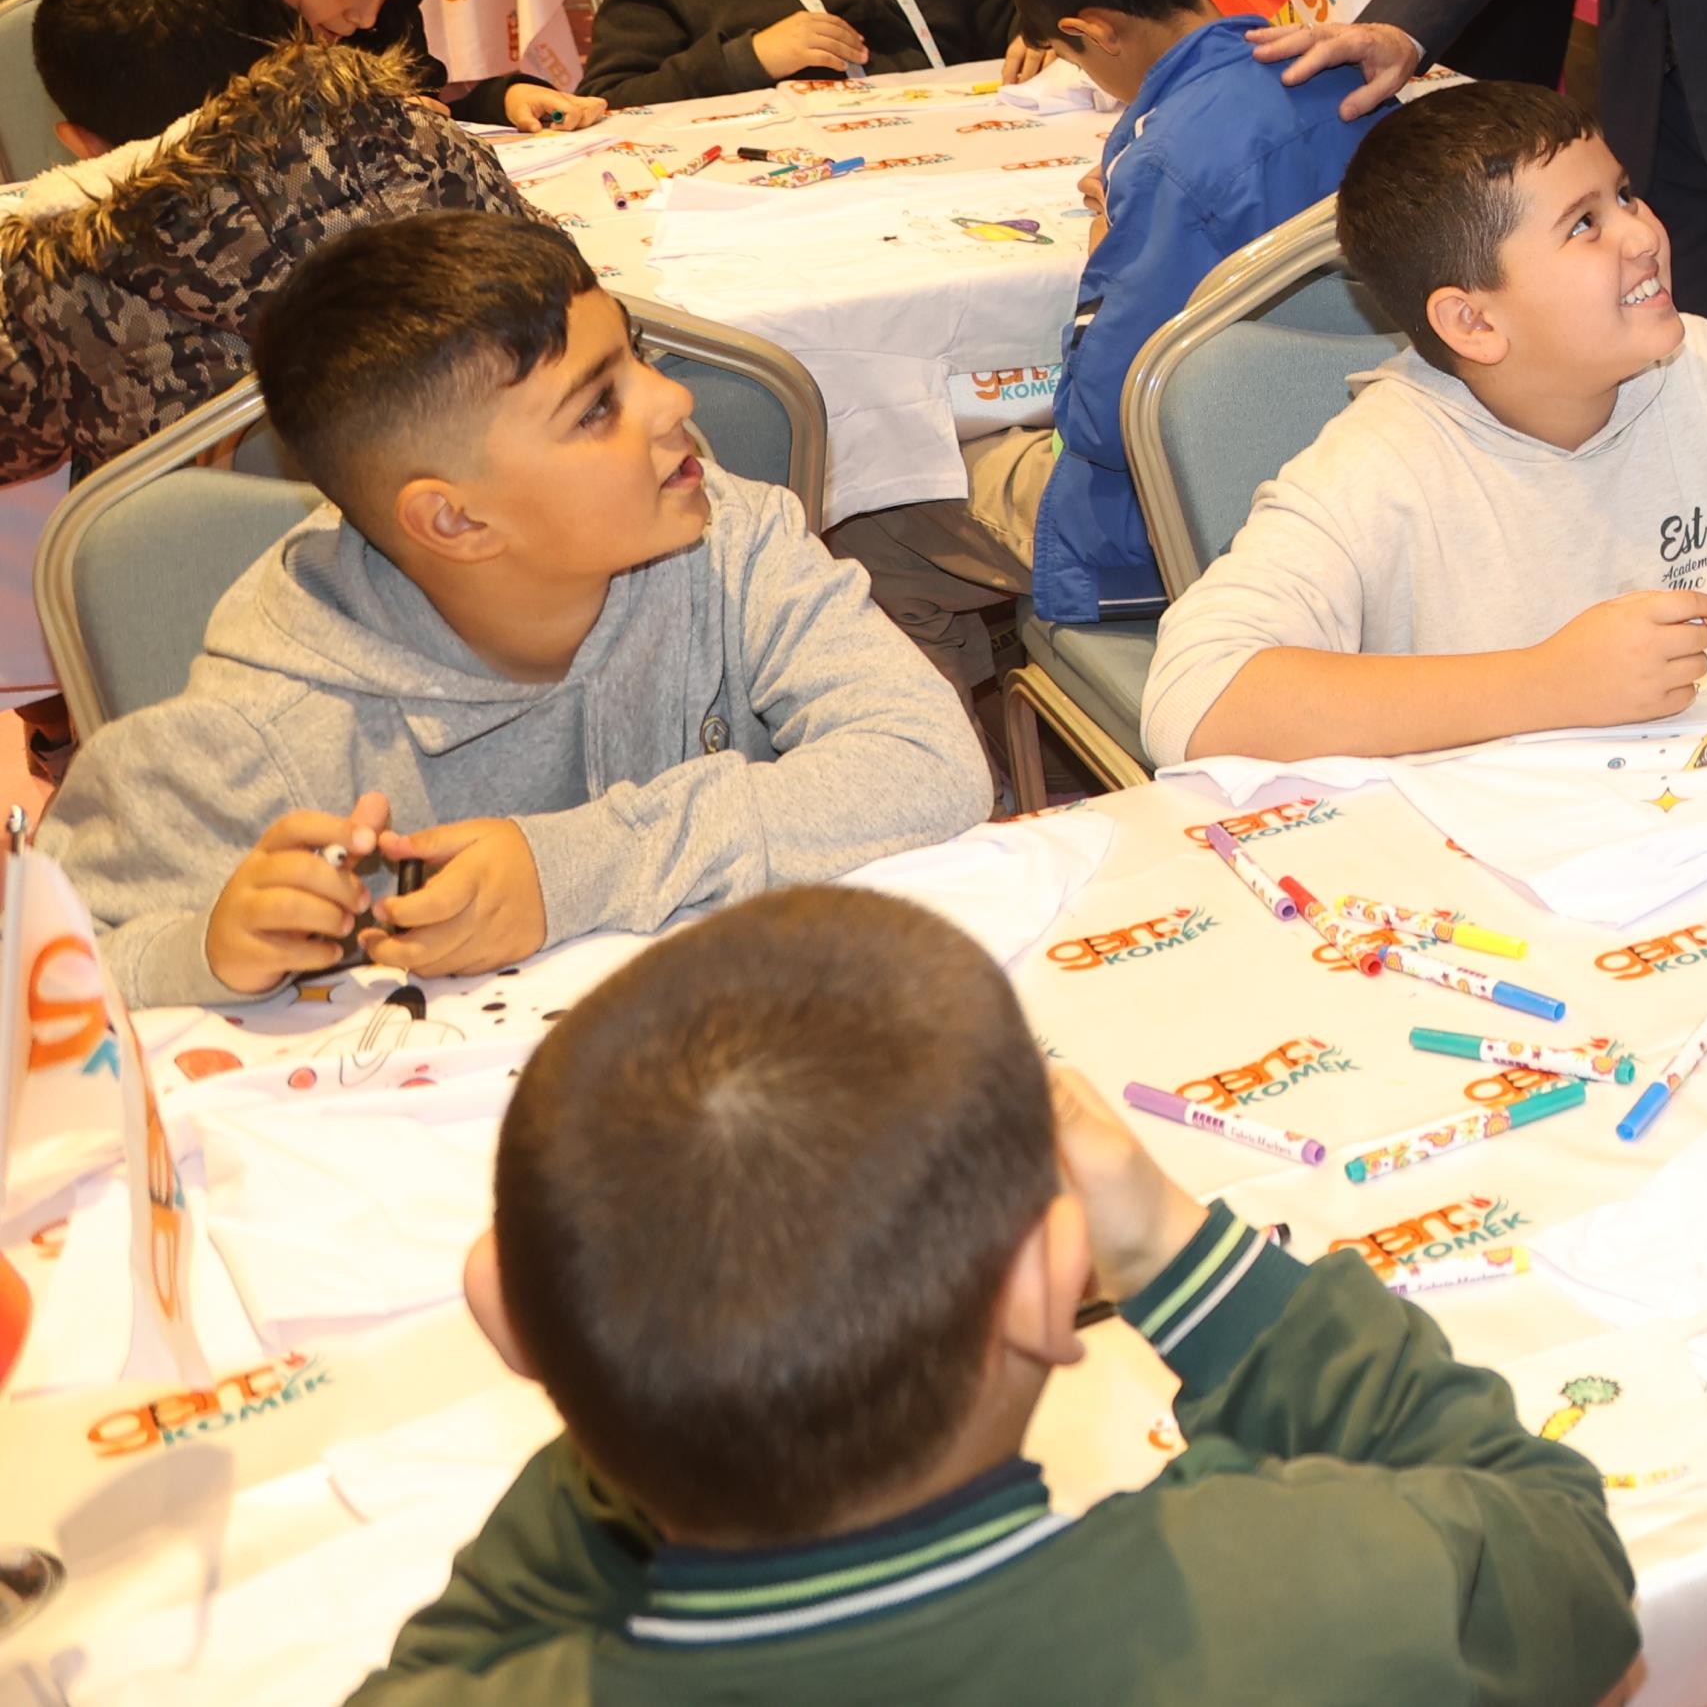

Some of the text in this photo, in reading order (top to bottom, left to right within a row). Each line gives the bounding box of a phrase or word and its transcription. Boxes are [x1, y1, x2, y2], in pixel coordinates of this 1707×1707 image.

[1000, 379, 1057, 401] KOME
[1236, 806, 1345, 843] KOMEK
[1103, 916, 1222, 966] KOMEK
[1236, 1059, 1362, 1106] KOMEK
[1397, 1212, 1533, 1265] KOMEK
